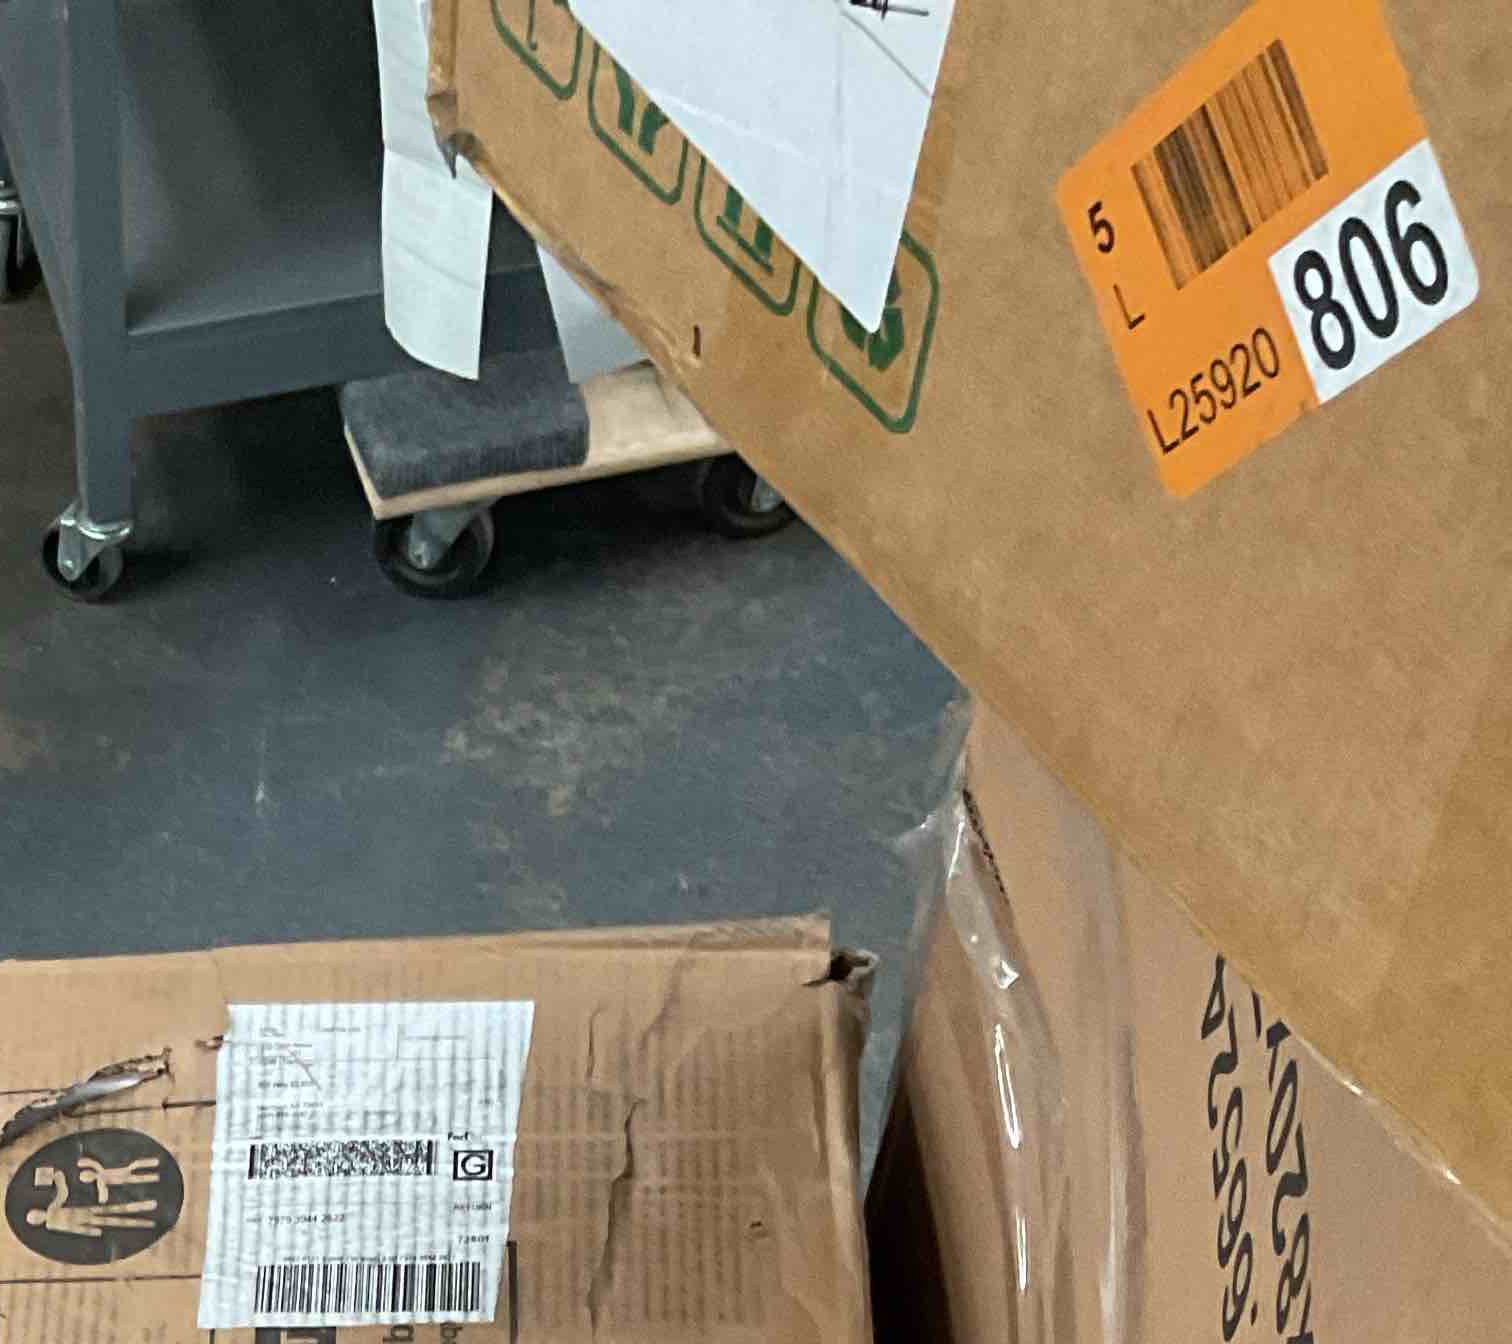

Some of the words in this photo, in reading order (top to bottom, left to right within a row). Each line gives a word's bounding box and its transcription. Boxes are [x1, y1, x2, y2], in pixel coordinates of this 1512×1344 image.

[1087, 201, 1116, 254] 5
[1113, 283, 1146, 330] L
[1293, 178, 1449, 370] 806
[1146, 327, 1281, 456] L25920
